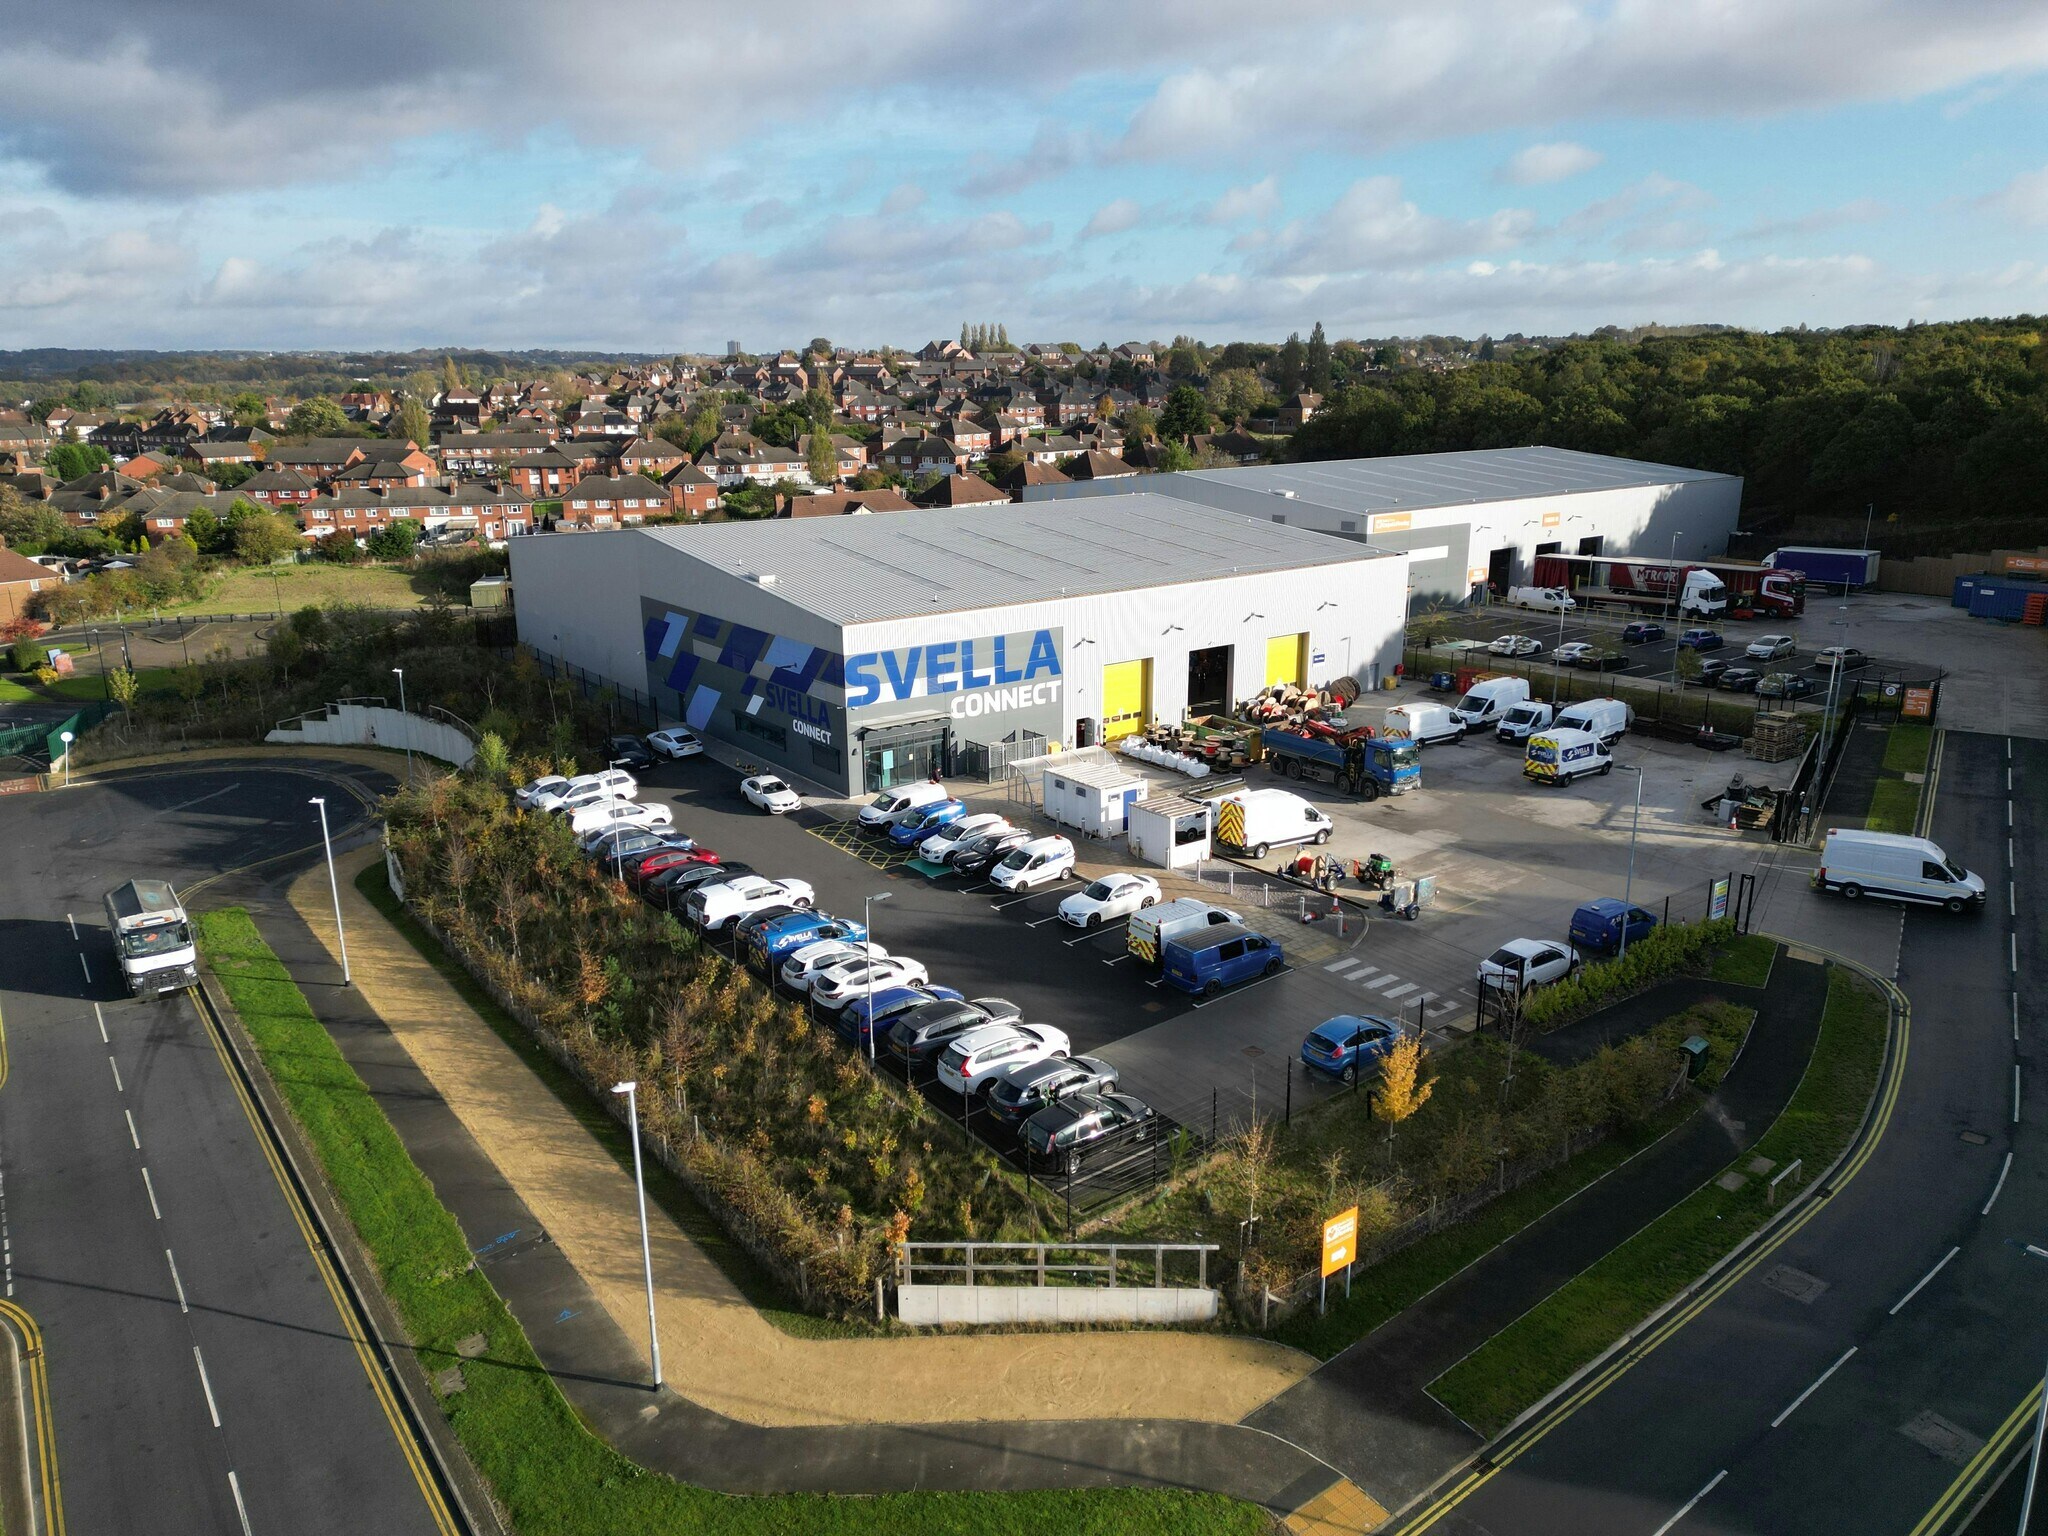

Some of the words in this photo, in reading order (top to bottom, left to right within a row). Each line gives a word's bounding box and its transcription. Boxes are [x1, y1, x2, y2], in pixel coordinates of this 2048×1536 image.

[845, 629, 1061, 708] SVELLA
[766, 683, 831, 729] SVELLA
[951, 680, 1062, 719] CONNECT
[793, 719, 831, 744] CONNECT
[788, 931, 812, 942] SVELLA
